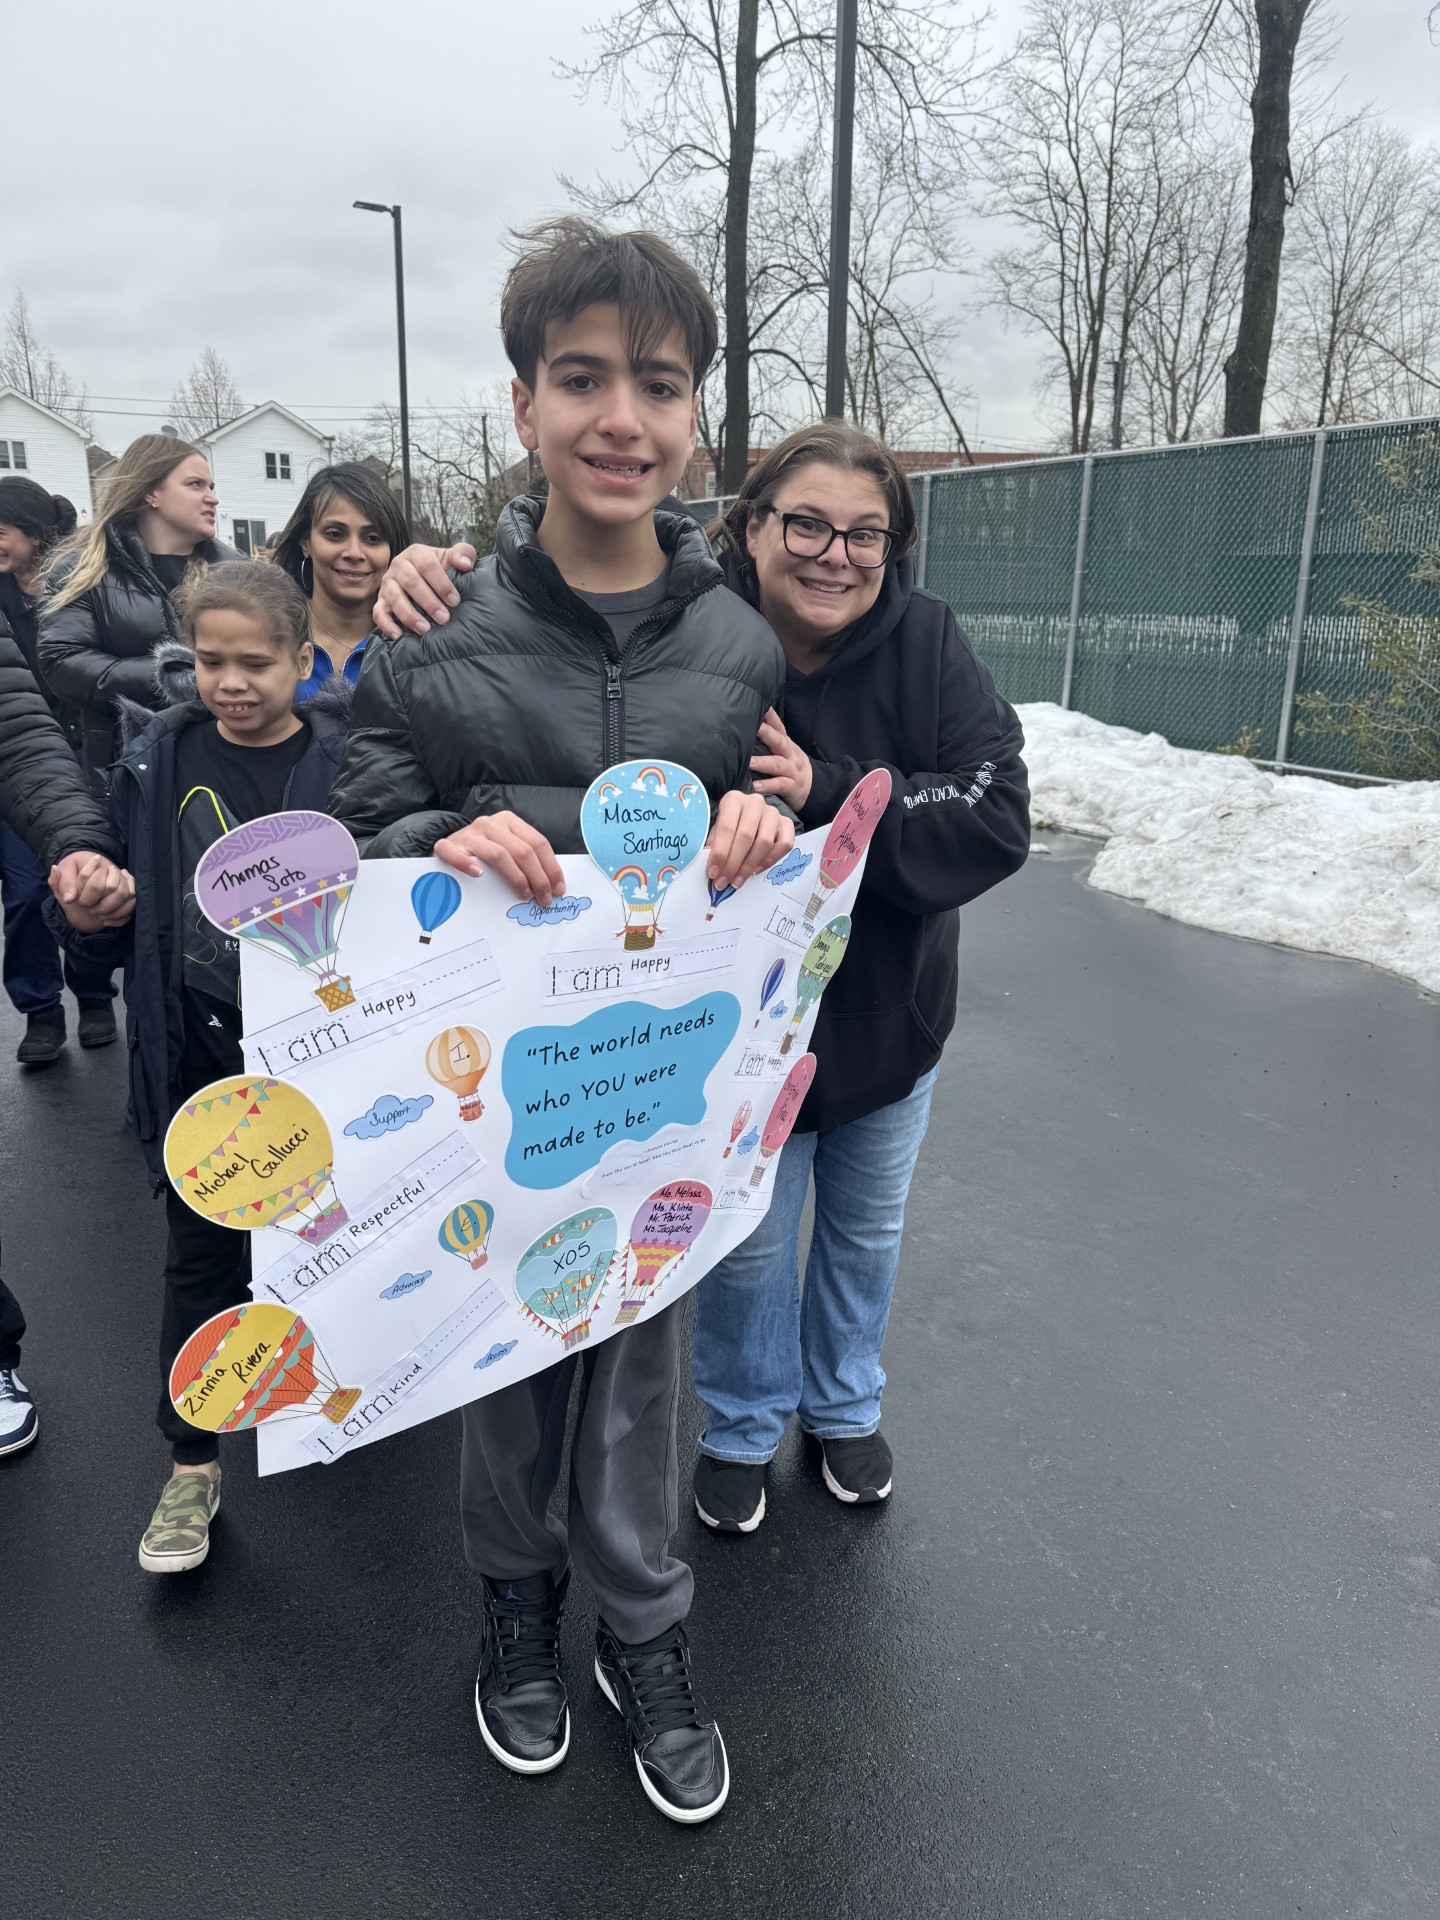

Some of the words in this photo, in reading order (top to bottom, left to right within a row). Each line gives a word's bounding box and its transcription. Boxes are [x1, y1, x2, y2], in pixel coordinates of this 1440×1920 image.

[604, 803, 666, 824] Mason
[623, 828, 689, 860] Santiago
[211, 856, 281, 891] Thomas
[267, 869, 307, 893] Soto
[529, 902, 581, 921] Opportunity
[776, 917, 796, 940] am
[552, 965, 556, 995] I
[573, 965, 620, 991] am
[631, 956, 671, 974] Happy
[257, 1047, 273, 1075] I
[288, 1022, 350, 1062] am
[362, 991, 416, 1018] Happy
[590, 1023, 651, 1055] world
[660, 1008, 715, 1039] needs
[746, 1054, 767, 1075] am
[525, 1089, 571, 1115] who
[582, 1073, 625, 1101] YOU
[634, 1063, 677, 1087] were
[369, 1105, 411, 1130] Support
[251, 1123, 310, 1180] Gallucci
[523, 1126, 585, 1160] made
[594, 1119, 615, 1139] to
[194, 1153, 250, 1203] Michael
[659, 1187, 673, 1198] Ms.
[674, 1185, 702, 1198] Melissa
[648, 1213, 660, 1223] Mr.
[662, 1212, 692, 1223] Patrick
[652, 1202, 667, 1212] Ms.
[264, 1283, 285, 1304] I
[293, 1241, 351, 1288] am
[349, 1180, 425, 1237] Respectful
[643, 1224, 656, 1233] Ms.
[657, 1224, 692, 1237] Jacqueline
[392, 1276, 425, 1295] Advocacy
[231, 1342, 272, 1385] Rivera
[183, 1367, 228, 1417] Zinnia
[317, 1438, 335, 1456] I
[343, 1393, 394, 1438] am
